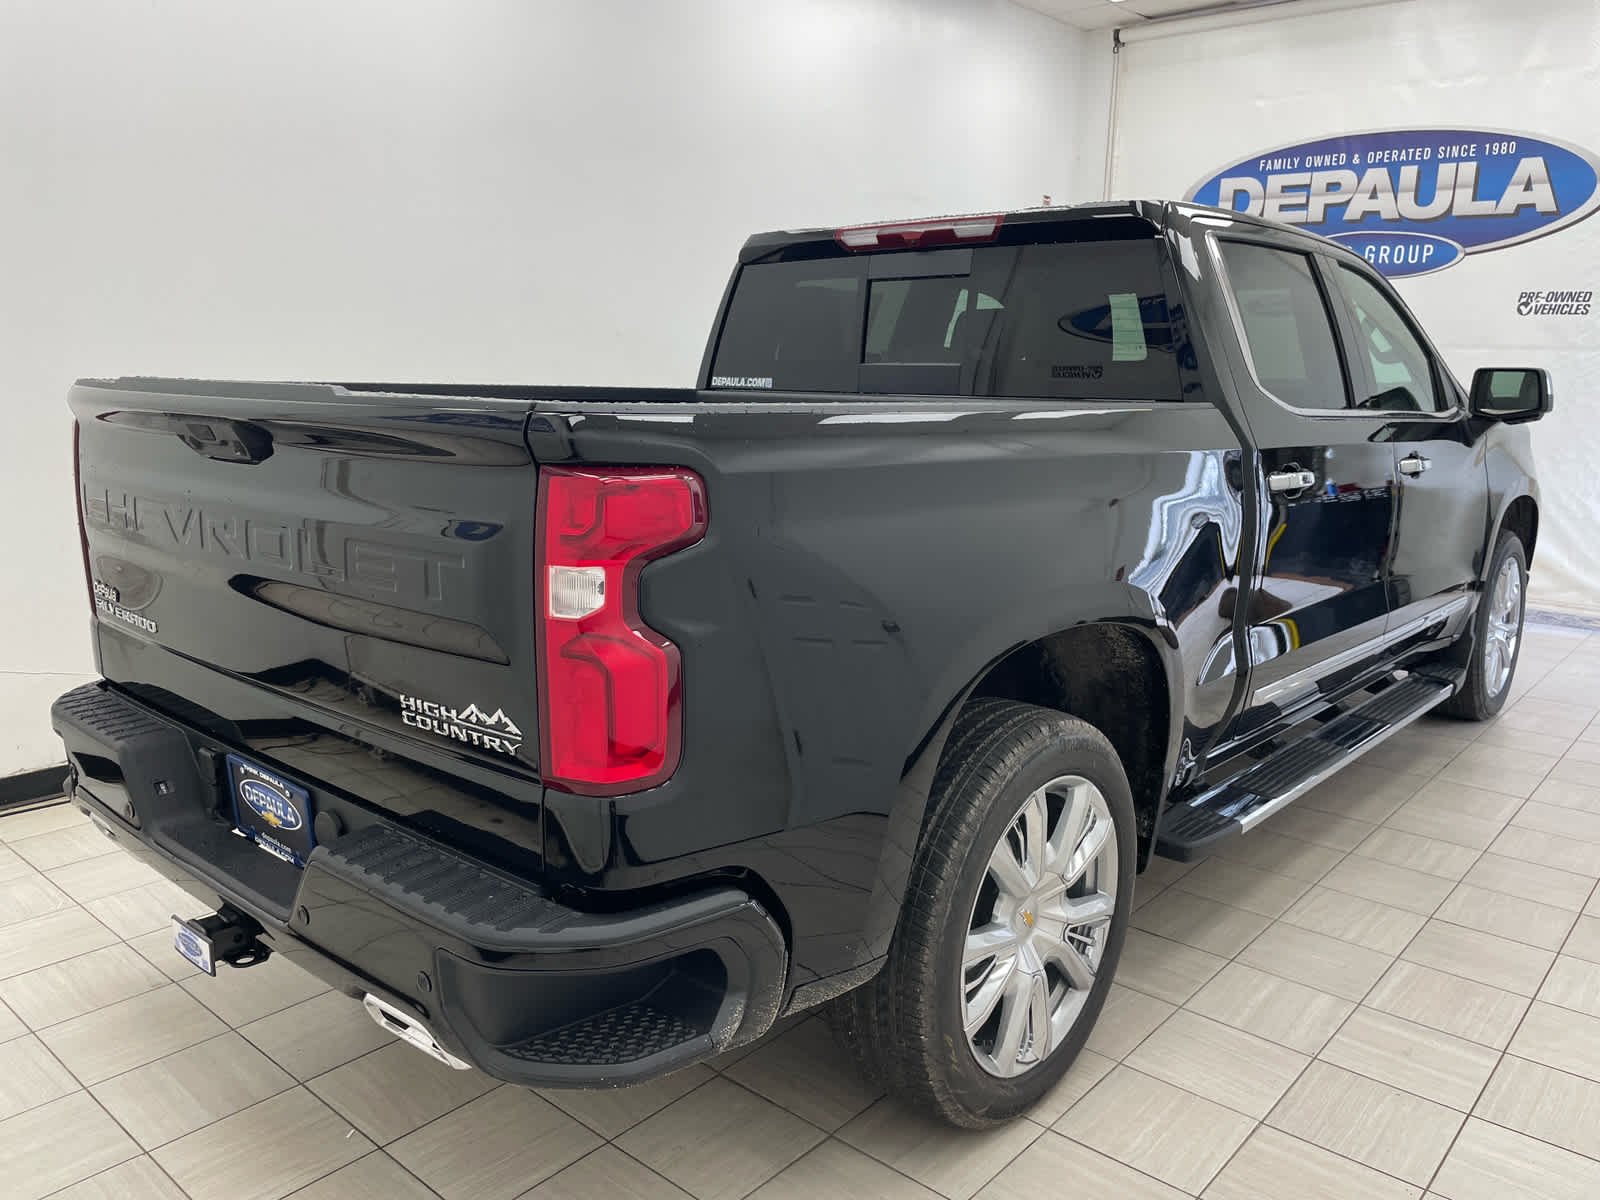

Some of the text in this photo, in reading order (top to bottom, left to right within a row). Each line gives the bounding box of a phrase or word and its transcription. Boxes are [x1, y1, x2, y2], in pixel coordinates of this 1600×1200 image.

[1259, 141, 1517, 172] FAMILY OWNED & OPERATED SINCE 1980
[1218, 156, 1559, 223] DEPAULA
[1364, 244, 1434, 265] GROUP
[1518, 291, 1593, 303] PRE-OWNED
[1534, 303, 1591, 315] VEHICLES
[711, 376, 766, 388] DEPAULA.COM
[95, 598, 158, 634] SILVERADO
[400, 694, 458, 722] HIGH
[402, 710, 522, 756] COUNTRY
[244, 784, 297, 826] DEPAULA
